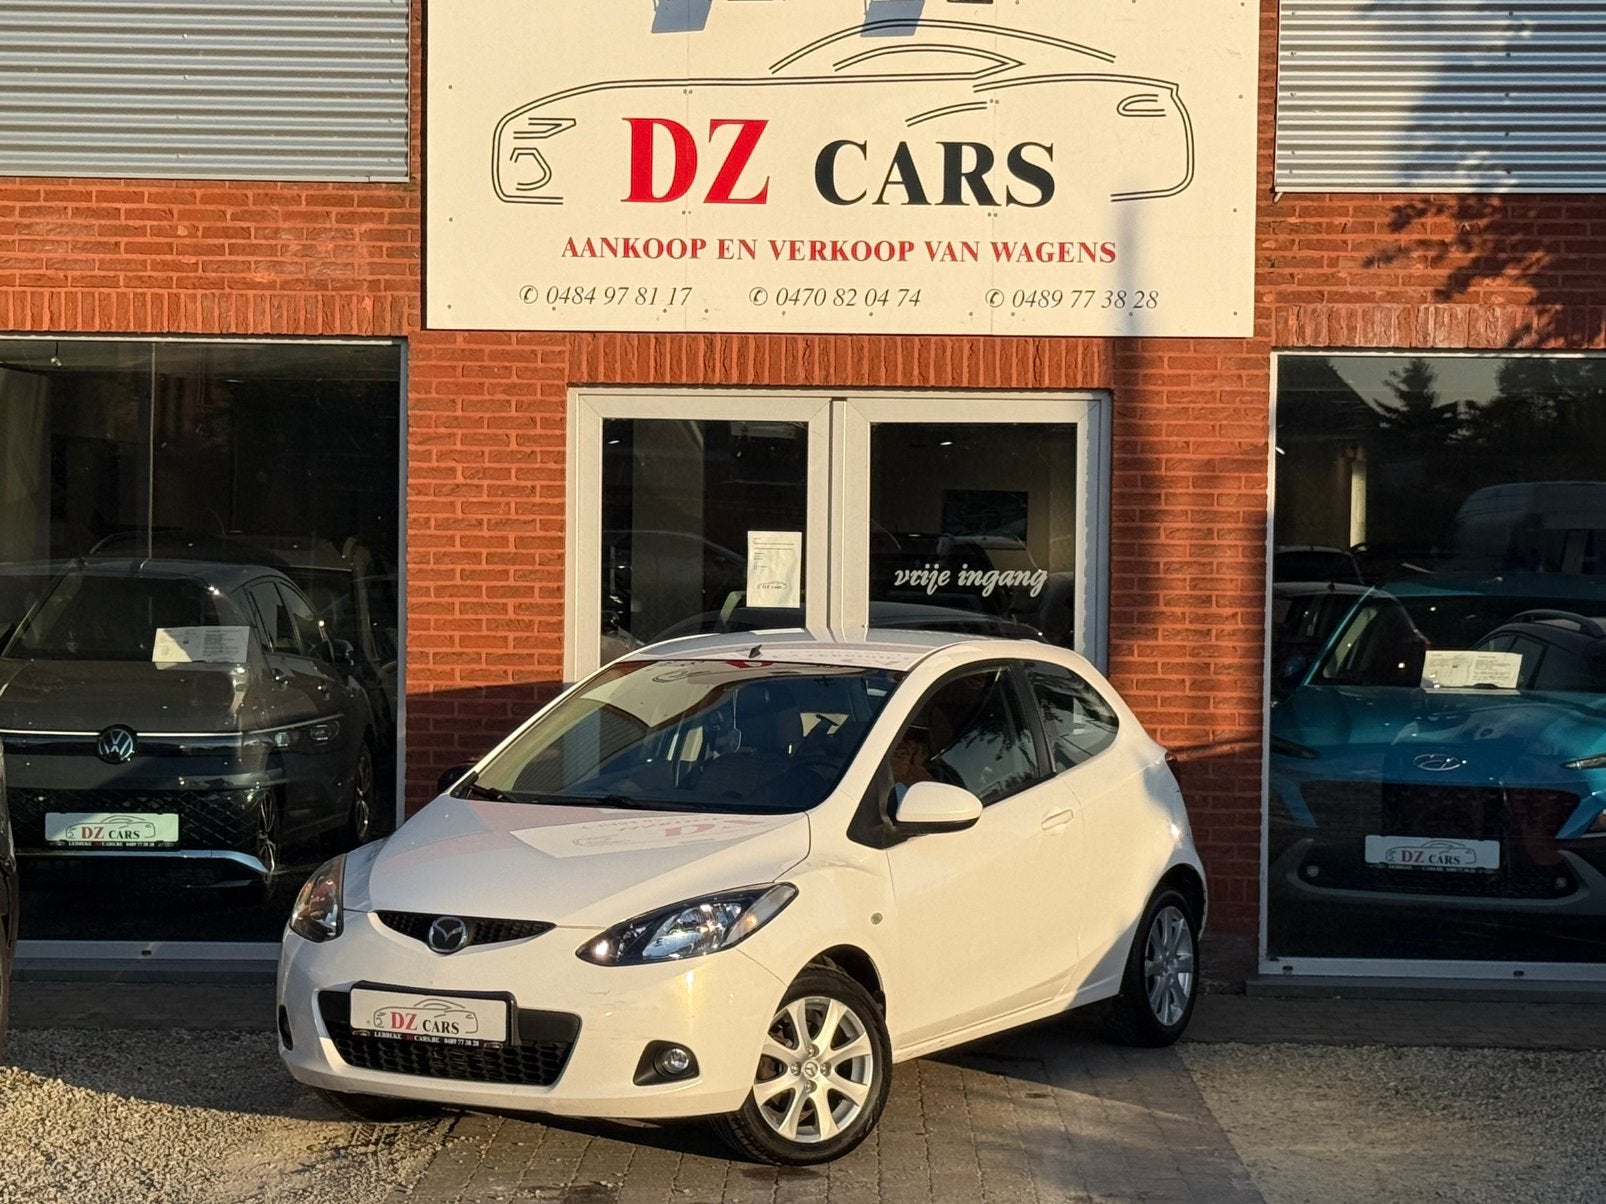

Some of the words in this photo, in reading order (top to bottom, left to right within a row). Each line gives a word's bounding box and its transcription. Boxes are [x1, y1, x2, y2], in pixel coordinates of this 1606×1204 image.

[620, 118, 770, 205] DZ
[815, 140, 1055, 208] CARS
[561, 236, 707, 260] AANKOOP
[716, 238, 757, 261] EN
[768, 239, 915, 262] VERKOOP
[923, 240, 981, 263] VAN
[990, 241, 1116, 264] WAGENS
[546, 285, 597, 305] 0484
[603, 286, 630, 306] 97
[634, 286, 659, 306] 81
[665, 286, 693, 306] 17
[775, 287, 827, 307] 0470
[832, 287, 858, 307] 82
[864, 287, 890, 307] 04
[897, 288, 922, 308] 74
[1012, 289, 1064, 309] 0489
[1070, 289, 1096, 309] 77
[1101, 289, 1128, 309] 38
[1132, 290, 1159, 310] 28
[894, 563, 951, 596] vrije
[957, 563, 1048, 598] ingang
[81, 826, 105, 840] DZ
[108, 830, 140, 840] CARS
[1401, 849, 1425, 863] DZ
[1428, 854, 1461, 865] CARS
[390, 1011, 418, 1031] DZ
[422, 1019, 460, 1035] CARS
